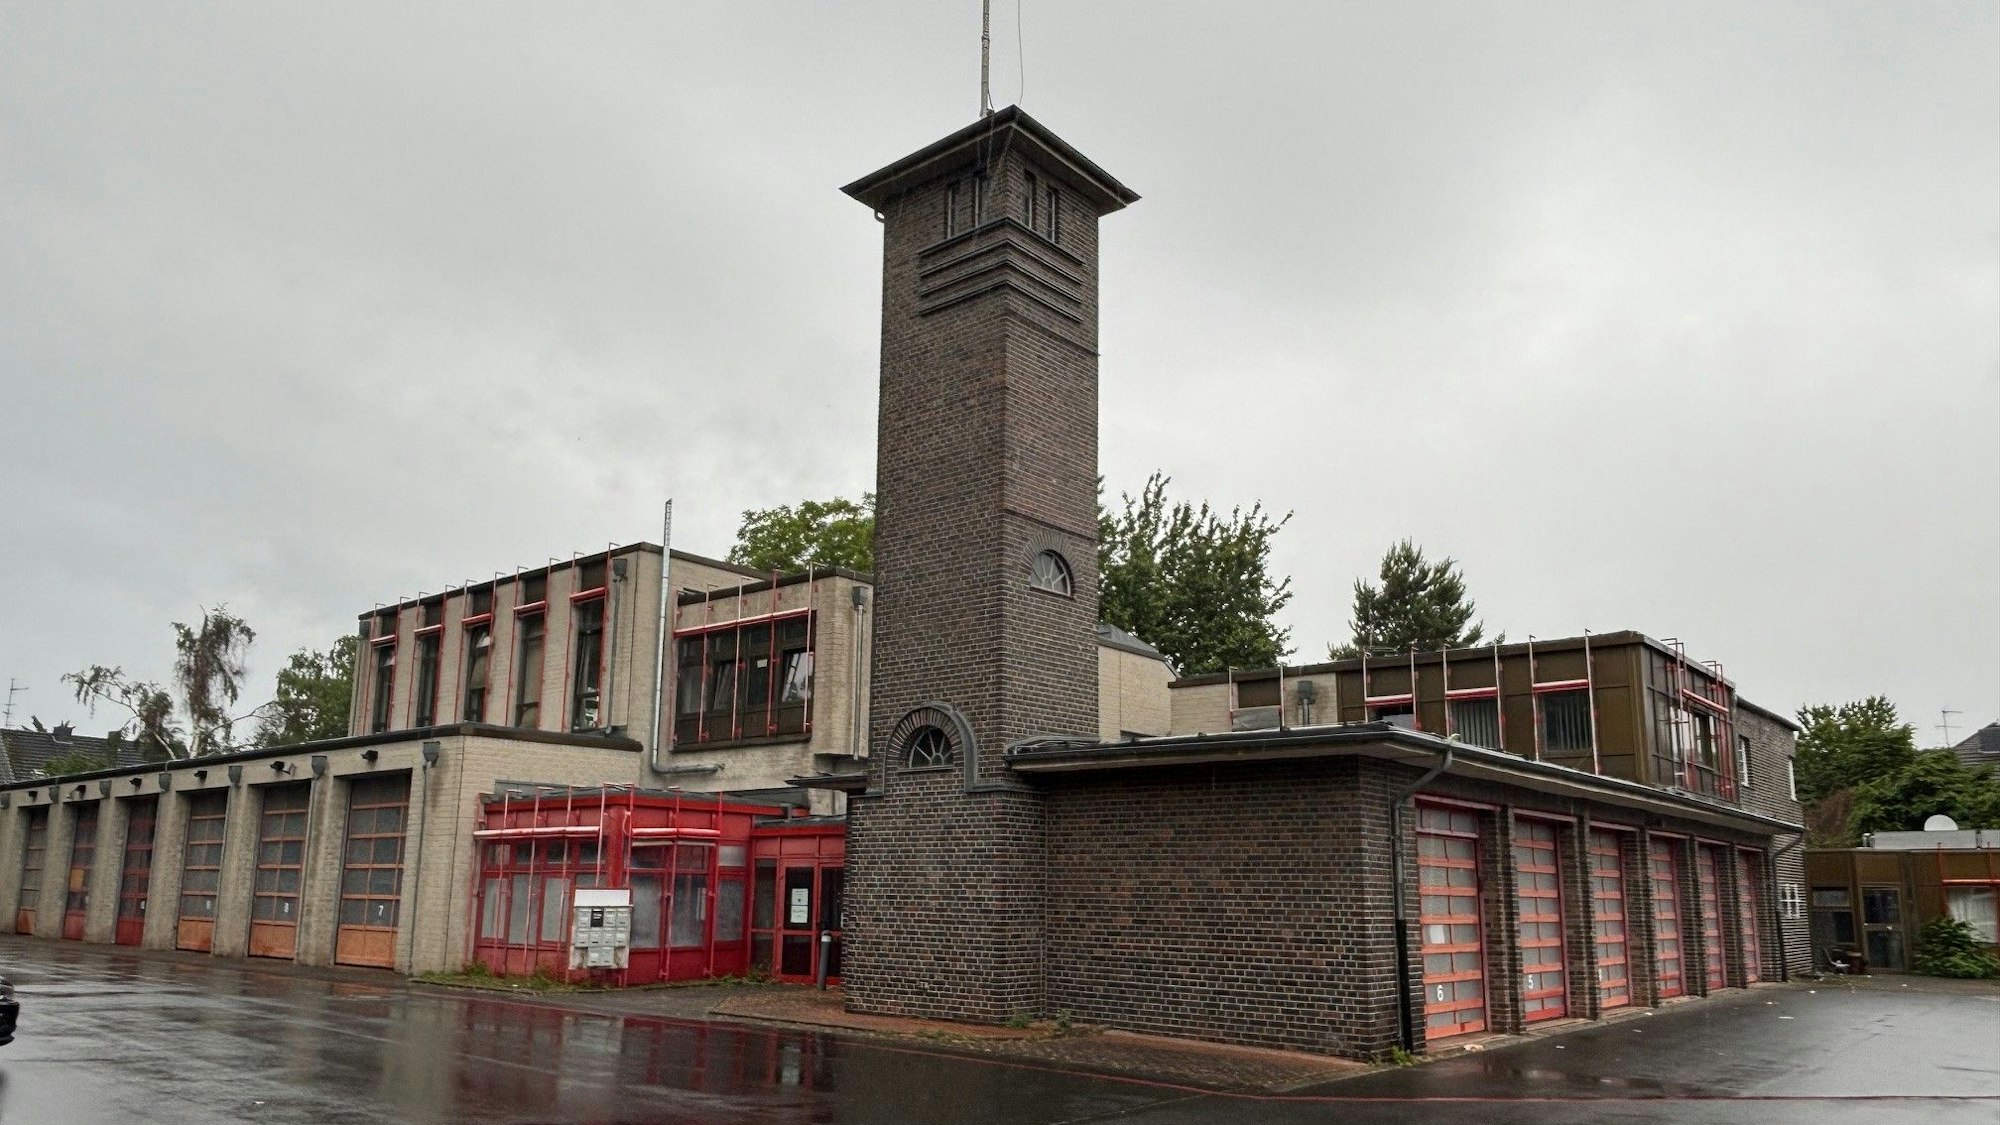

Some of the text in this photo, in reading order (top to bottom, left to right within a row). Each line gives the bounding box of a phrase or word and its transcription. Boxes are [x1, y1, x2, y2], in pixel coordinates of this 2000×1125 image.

[378, 904, 384, 916] 7
[1528, 974, 1534, 990] 5
[1437, 984, 1444, 1001] 6
